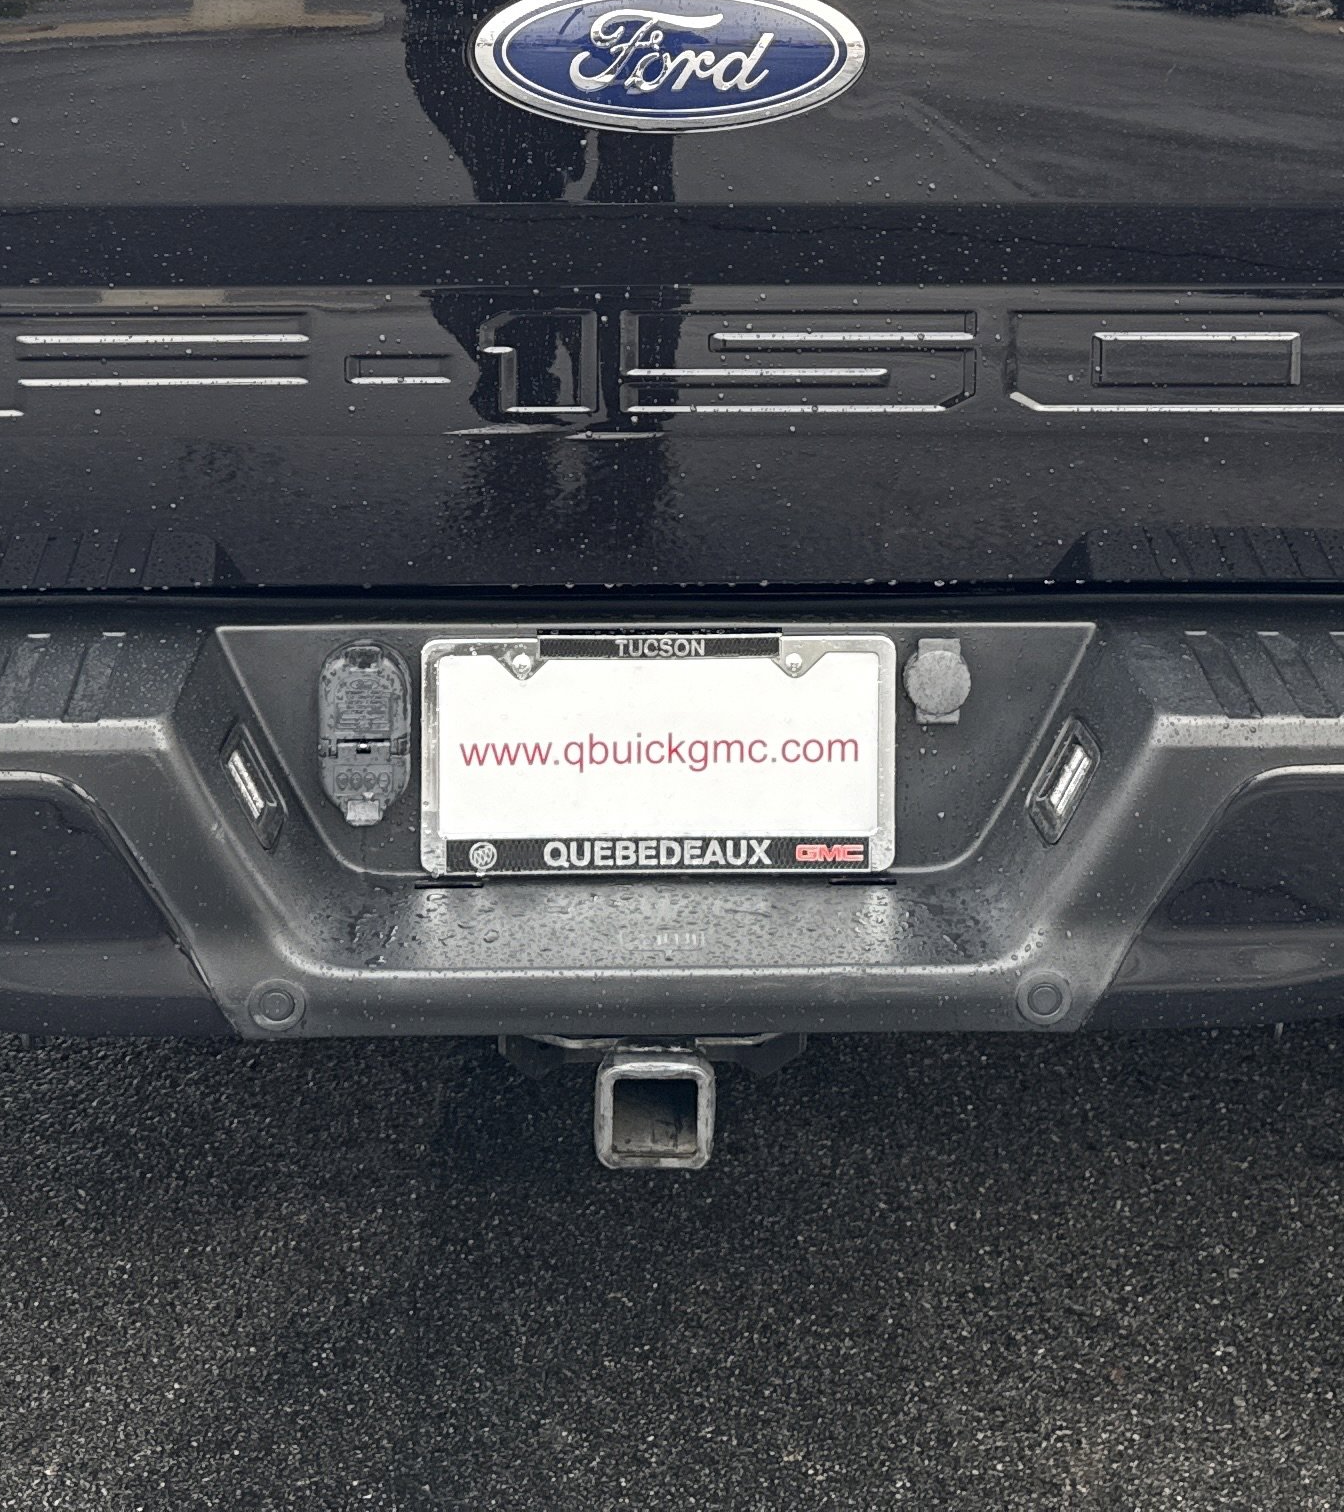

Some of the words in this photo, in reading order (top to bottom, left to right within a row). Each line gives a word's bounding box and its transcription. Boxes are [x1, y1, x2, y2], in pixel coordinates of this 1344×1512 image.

[568, 7, 775, 94] Ford
[614, 638, 706, 657] TUCSON
[459, 732, 859, 773] www.qbuickgmc.com
[543, 839, 773, 868] QUEBEDEAUX
[795, 843, 864, 862] GMC
